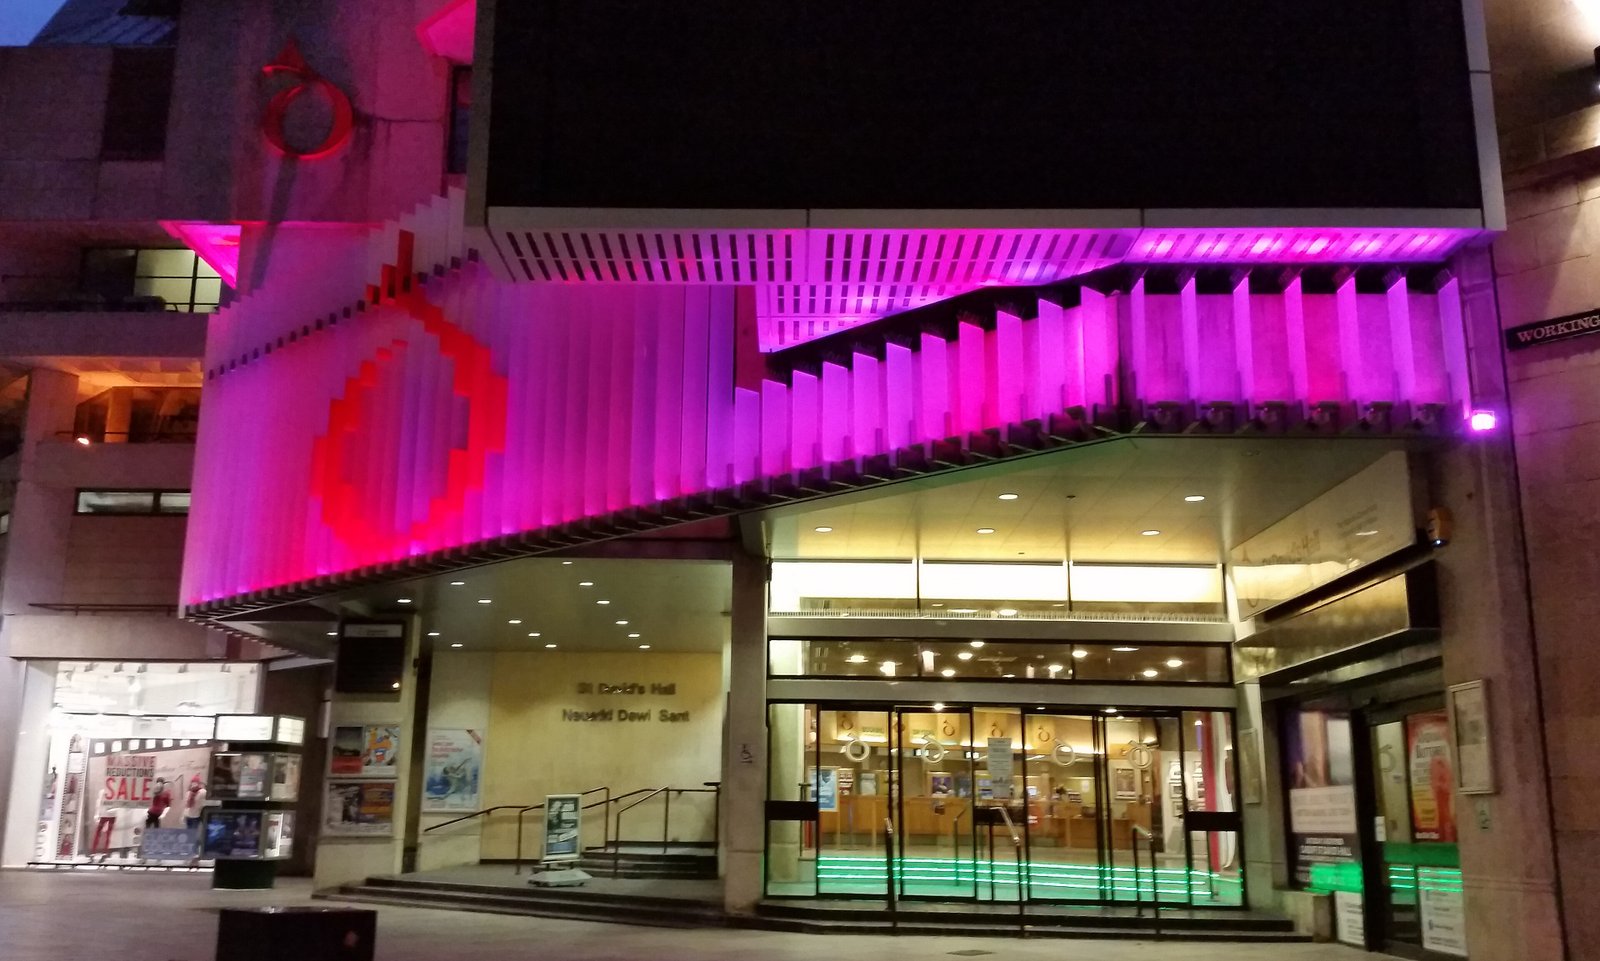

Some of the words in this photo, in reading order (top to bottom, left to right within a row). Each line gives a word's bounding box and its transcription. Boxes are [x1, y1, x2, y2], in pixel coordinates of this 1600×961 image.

[1517, 315, 1600, 342] WORKING
[651, 682, 676, 695] Hall
[618, 709, 651, 722] Dewi
[658, 709, 690, 722] Sant
[106, 756, 155, 767] MASSIVE
[106, 768, 154, 777] REDUCTIONS
[105, 777, 153, 800] SALE
